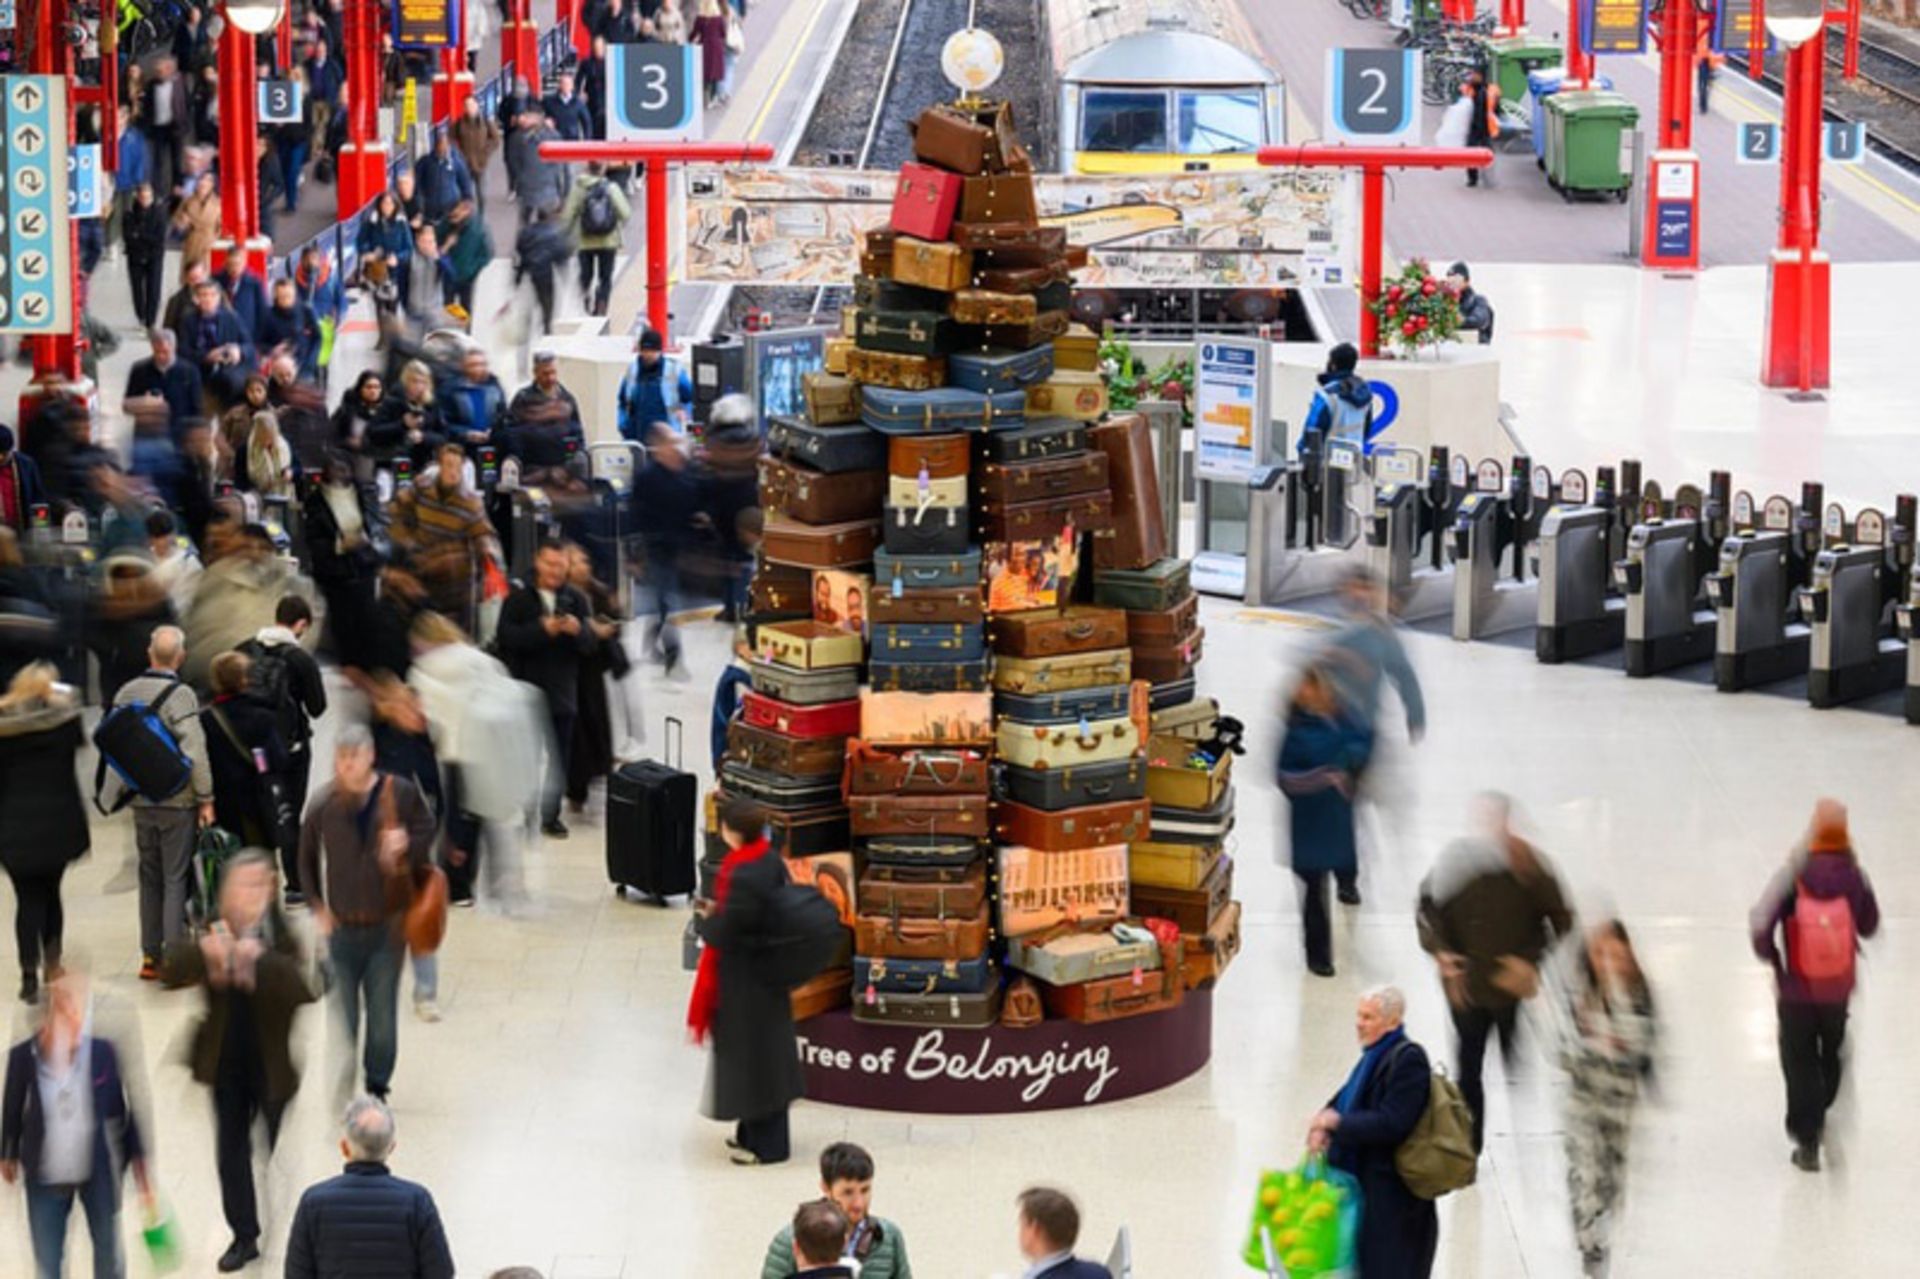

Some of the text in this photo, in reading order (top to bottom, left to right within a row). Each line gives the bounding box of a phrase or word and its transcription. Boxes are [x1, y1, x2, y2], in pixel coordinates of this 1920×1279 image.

[272, 88, 287, 111] 3
[640, 63, 669, 110] 3
[1358, 67, 1388, 114] 2
[1751, 131, 1766, 152] 2
[1838, 130, 1848, 152] 1
[795, 1029, 1119, 1102] Tree of Belonging
